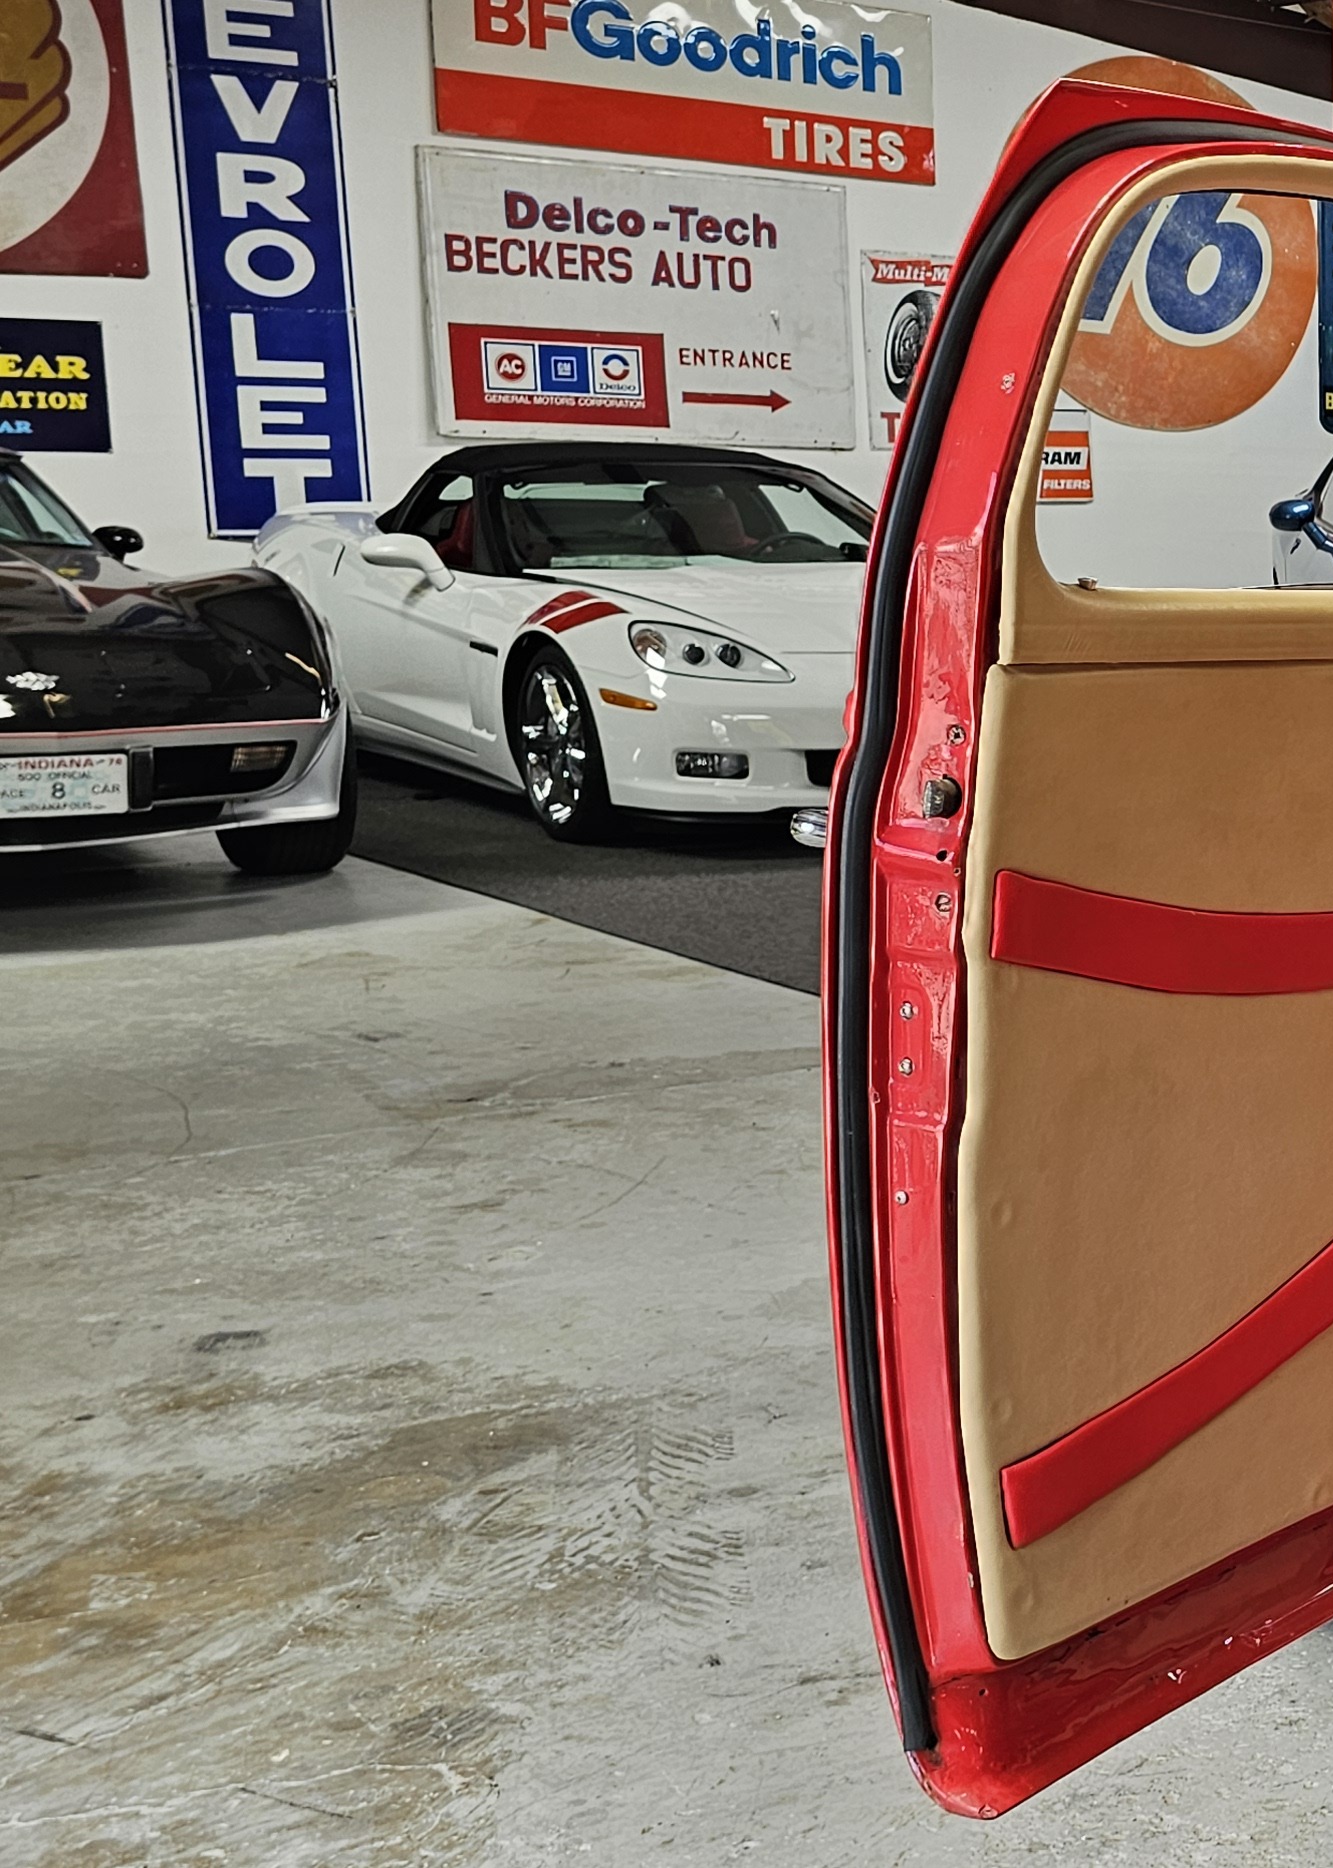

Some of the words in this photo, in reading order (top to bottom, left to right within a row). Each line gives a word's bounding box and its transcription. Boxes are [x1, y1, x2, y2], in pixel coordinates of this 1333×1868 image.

[475, 0, 903, 95] BFGoodrich
[763, 116, 905, 172] TIRES
[504, 189, 778, 249] Delco-Tech
[444, 233, 634, 285] BECKERS
[651, 250, 753, 293] AUTO
[678, 347, 793, 371] ENTRANCE
[499, 362, 522, 375] AC
[557, 361, 572, 376] GM
[599, 382, 636, 392] Delco
[484, 394, 531, 405] GENERAL
[533, 396, 576, 407] MOTORS
[578, 397, 646, 409] CORPORATION
[1043, 479, 1091, 490] FILTERS
[17, 758, 95, 770] INDIANA
[18, 773, 42, 782] 500
[51, 782, 66, 800] 8
[91, 784, 122, 795] CAR
